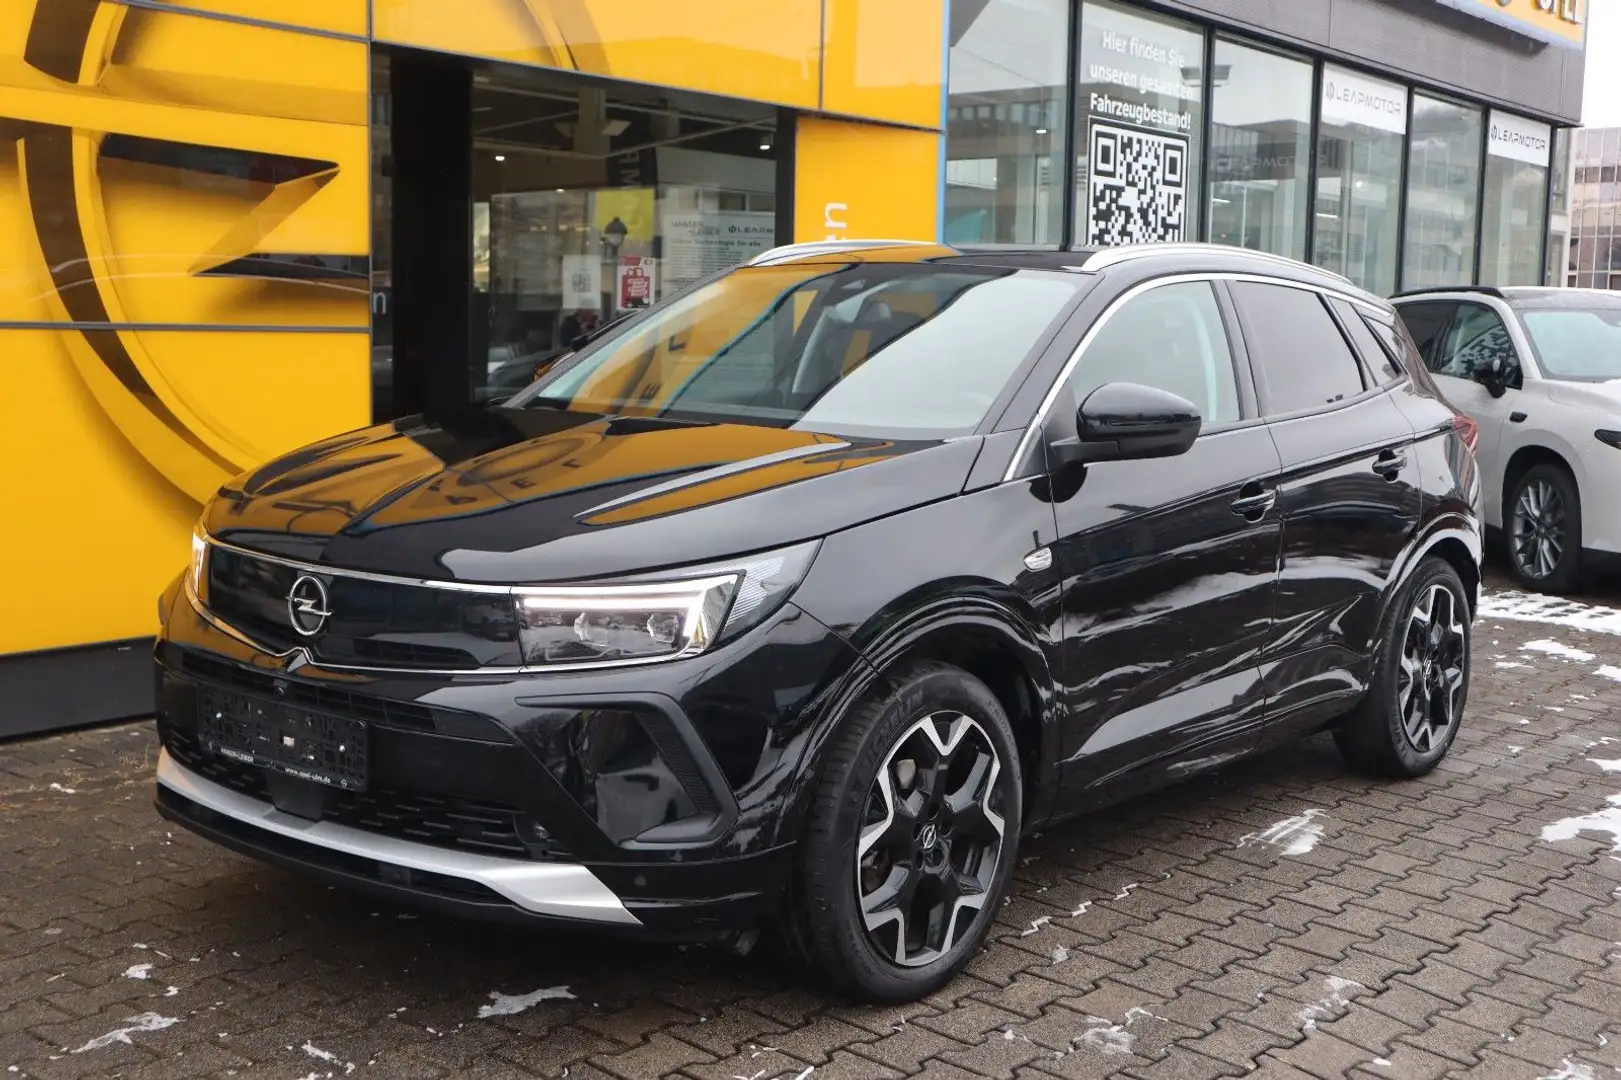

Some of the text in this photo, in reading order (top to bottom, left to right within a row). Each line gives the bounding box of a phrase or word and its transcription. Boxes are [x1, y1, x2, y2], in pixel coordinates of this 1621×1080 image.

[1102, 30, 1185, 68] Hier finden Sie
[1090, 63, 1193, 100] unseren gesamten
[1090, 92, 1192, 130] Fahrzeugbestand!
[1336, 87, 1401, 115] LEAPMOTOR
[1498, 131, 1547, 151] LEAPMOTOR
